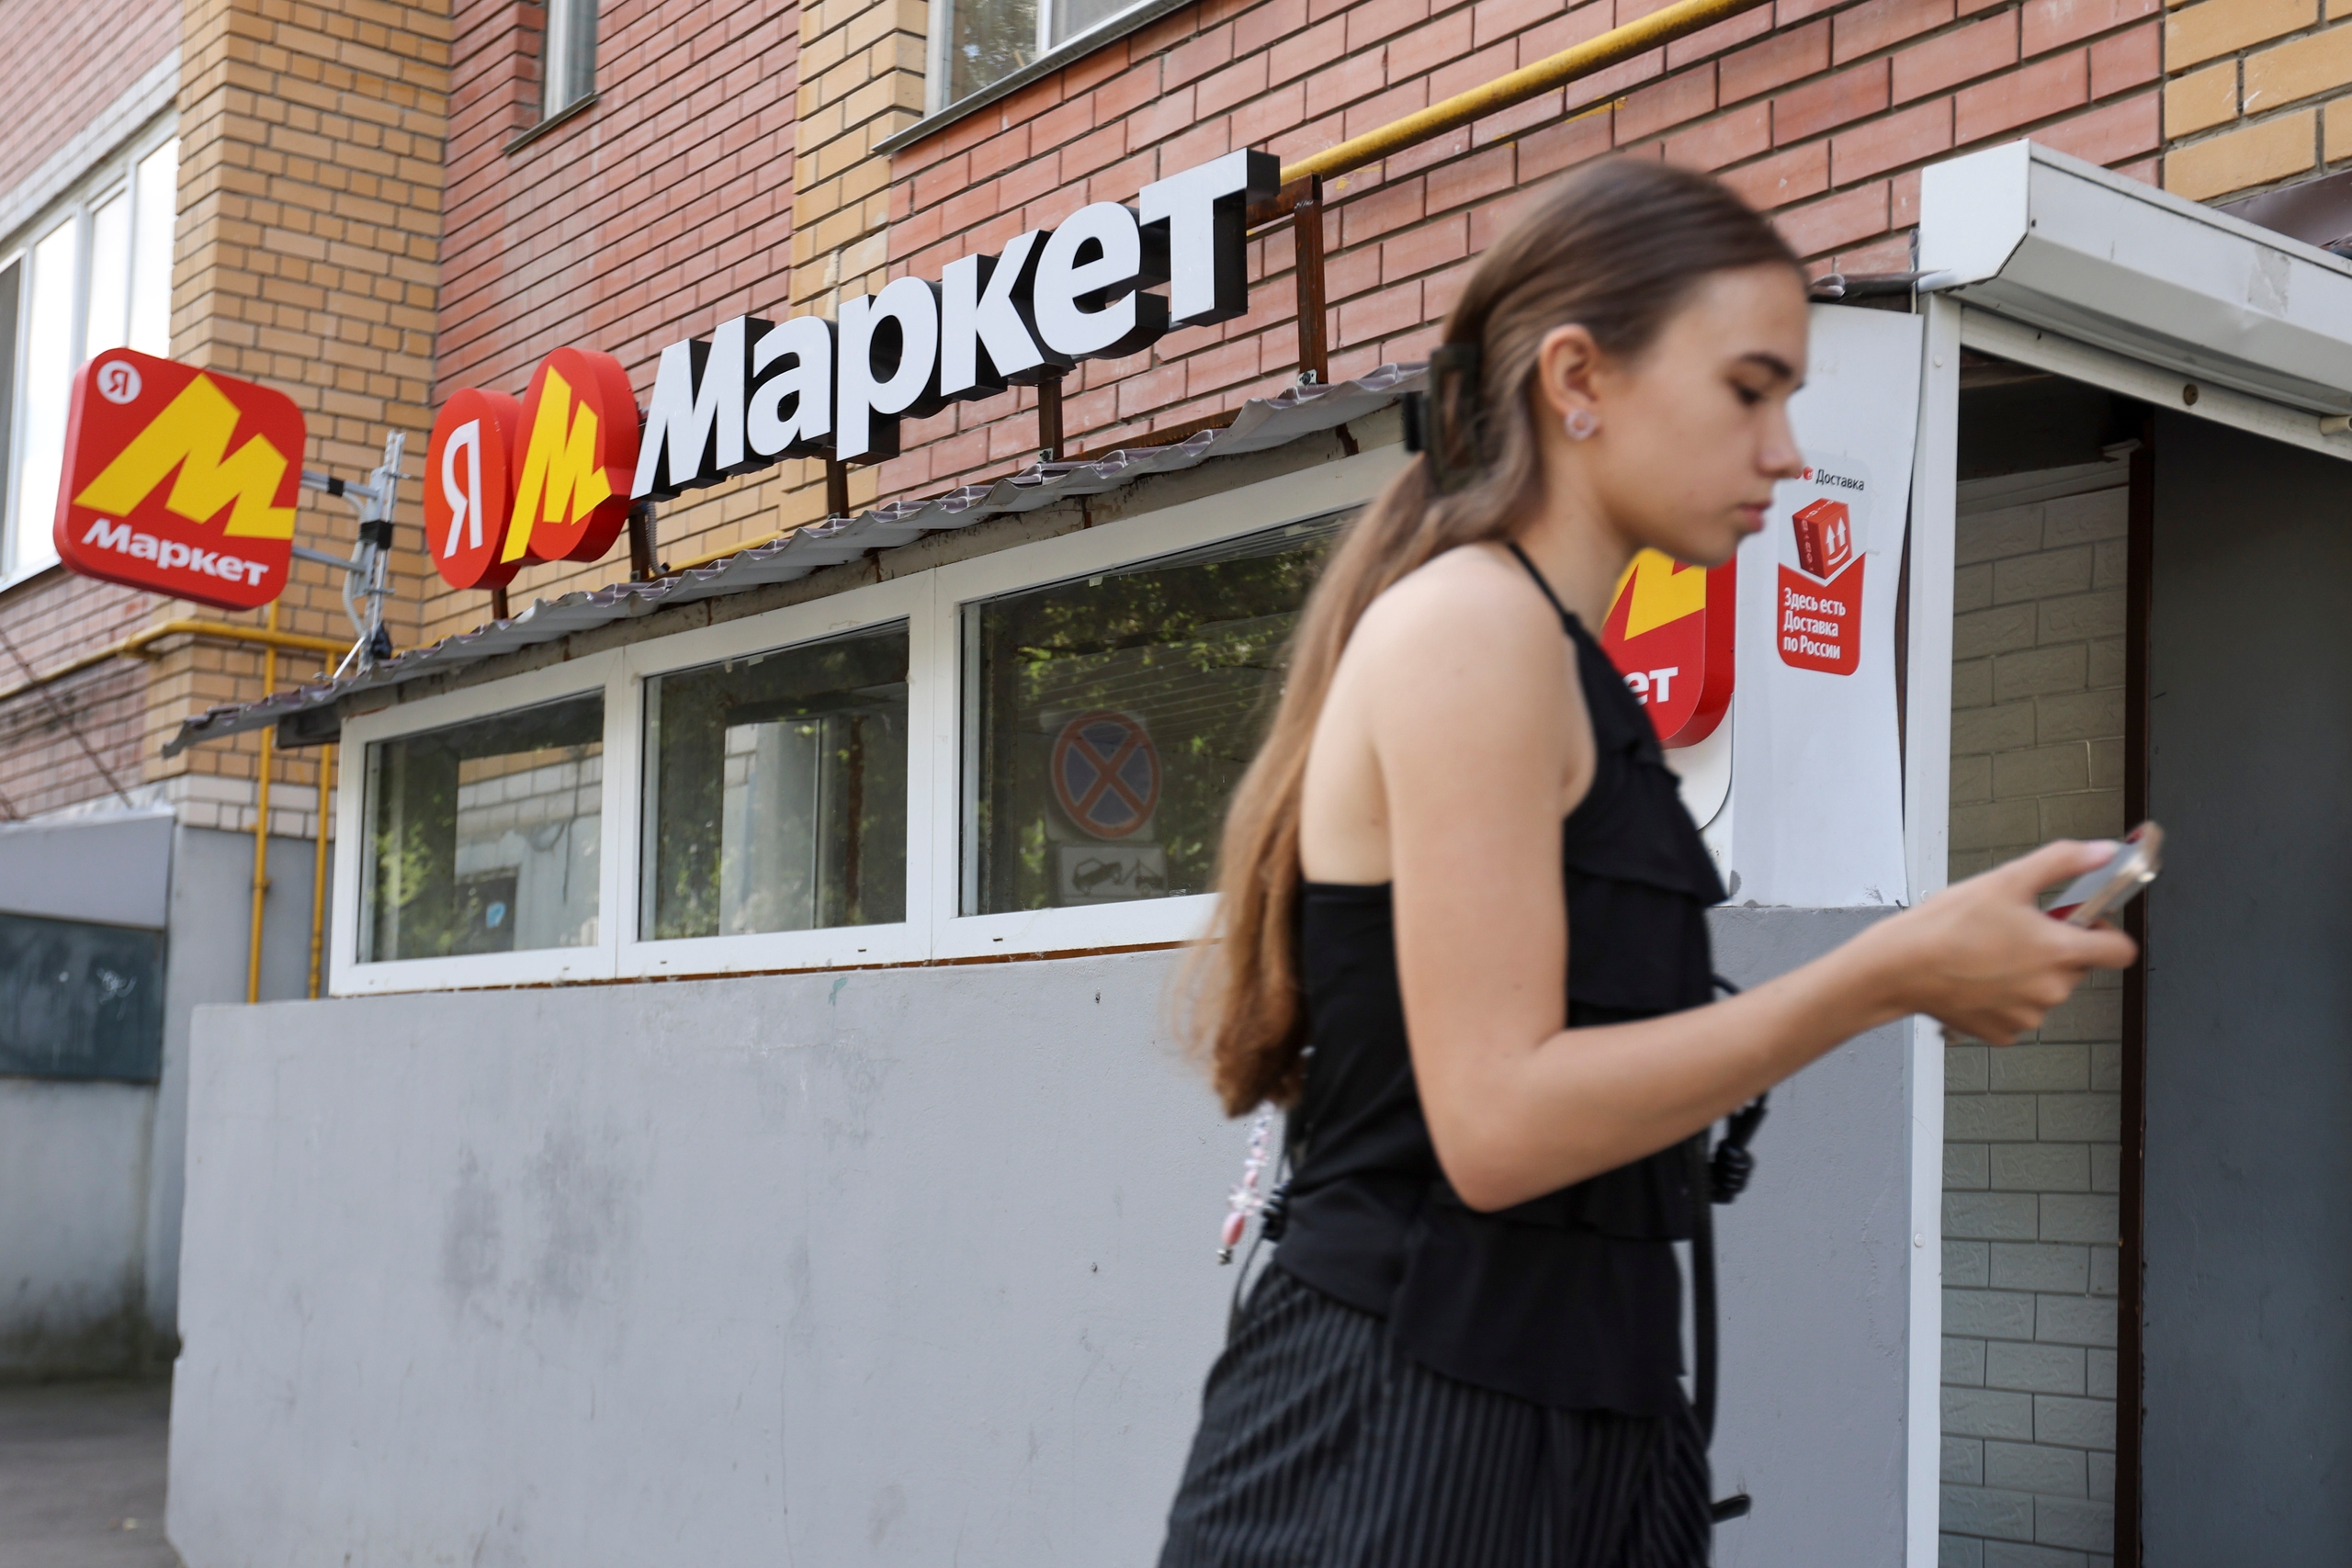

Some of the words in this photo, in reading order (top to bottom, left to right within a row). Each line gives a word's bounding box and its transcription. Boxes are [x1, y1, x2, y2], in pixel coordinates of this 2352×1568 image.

[440, 418, 484, 560] Я
[629, 147, 1250, 501] Маркет
[105, 366, 130, 399] Я
[1815, 468, 1865, 491] Доставка
[81, 518, 269, 587] Маркет
[1783, 586, 1818, 612] Здесь
[1820, 598, 1847, 616] есть
[1783, 609, 1839, 637] Доставка
[1783, 636, 1799, 652] по
[1799, 634, 1841, 660] России
